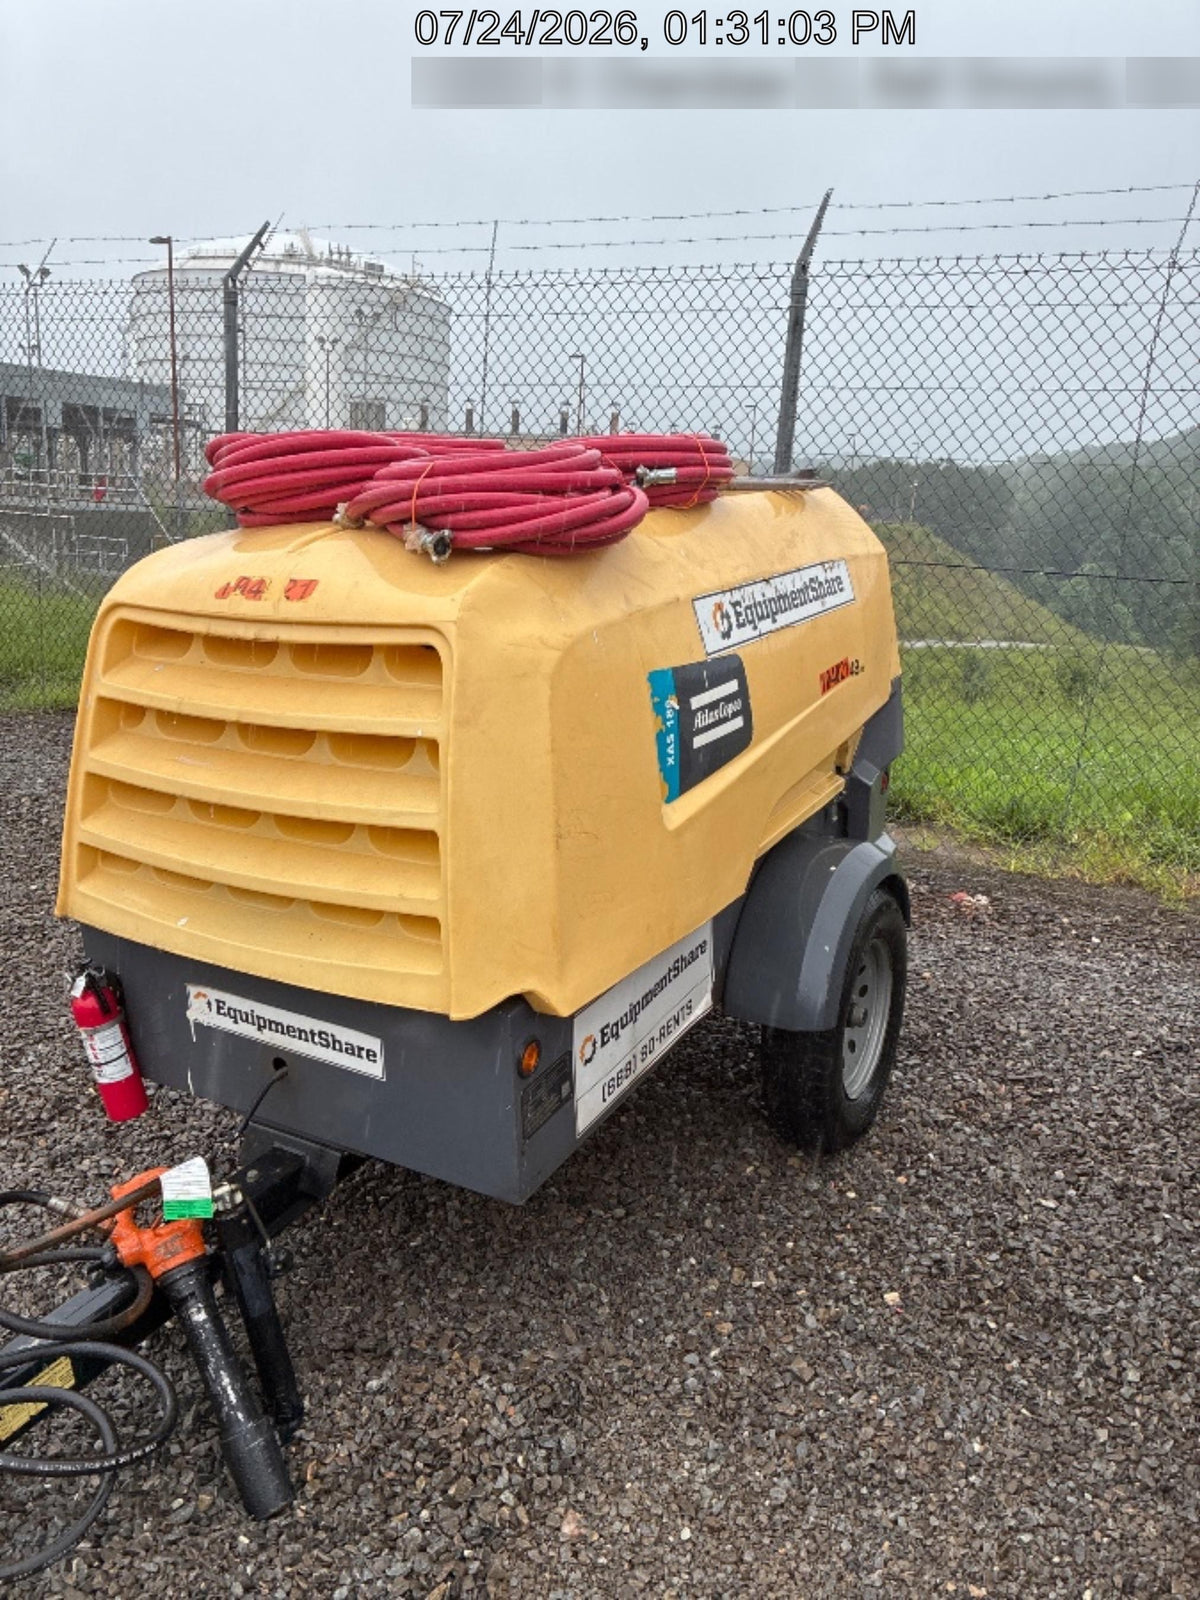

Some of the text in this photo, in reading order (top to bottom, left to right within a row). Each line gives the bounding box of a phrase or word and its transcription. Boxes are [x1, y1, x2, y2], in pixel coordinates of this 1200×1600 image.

[729, 574, 844, 631] EquipmentShare
[665, 733, 675, 767] XAS
[599, 939, 708, 1049] EquipmentShare
[214, 997, 378, 1064] EquipmentShare
